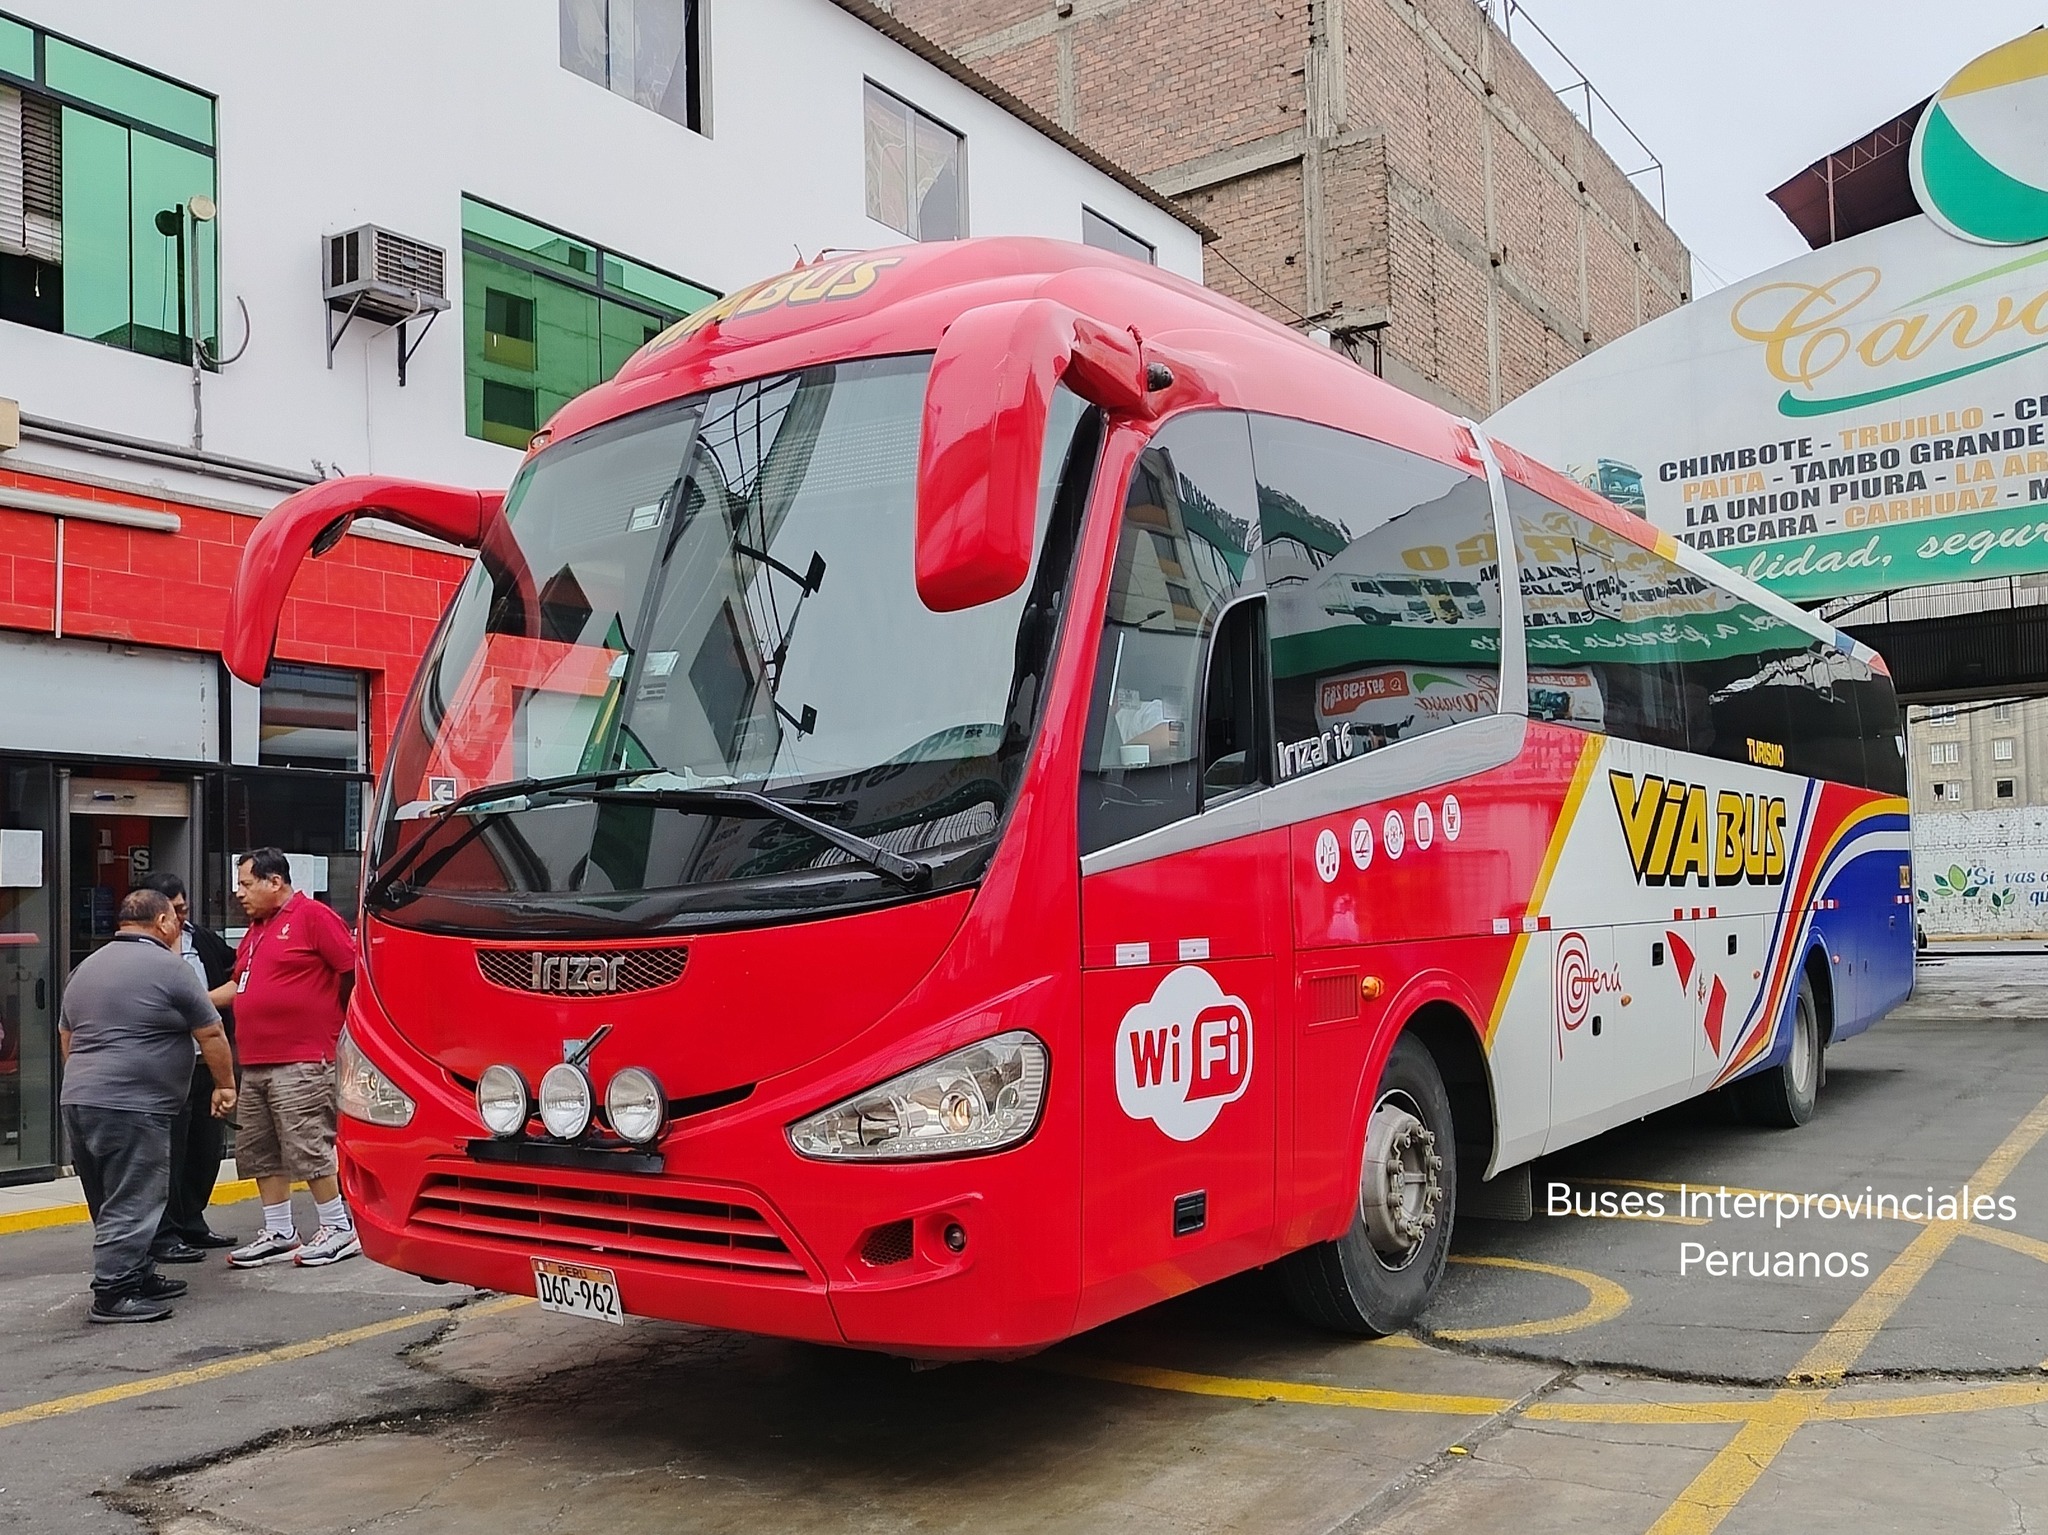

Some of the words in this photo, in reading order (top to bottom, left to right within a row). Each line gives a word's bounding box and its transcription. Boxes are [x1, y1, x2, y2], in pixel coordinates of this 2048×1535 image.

[1659, 437, 1813, 482] CHIMBOTE
[1838, 407, 1984, 450] TRUJILLO
[1683, 471, 1766, 503] PAITA
[1790, 448, 1900, 484] TAMBO
[1910, 424, 2045, 465] GRANDE
[1686, 504, 1719, 527] LA
[1727, 487, 1820, 520] UNION
[1830, 470, 1927, 504] PIURA
[1956, 459, 1995, 485] LA
[1845, 486, 1998, 528] CARHUAZ
[1277, 731, 1331, 778] Irizar
[1333, 721, 1354, 760] i6
[1746, 737, 1785, 767] TURISMO
[1974, 866, 1995, 885] Si
[2004, 872, 2035, 884] vas
[531, 951, 626, 991] Irizar
[558, 1265, 588, 1279] PERU
[538, 1272, 617, 1315] D6C-962
